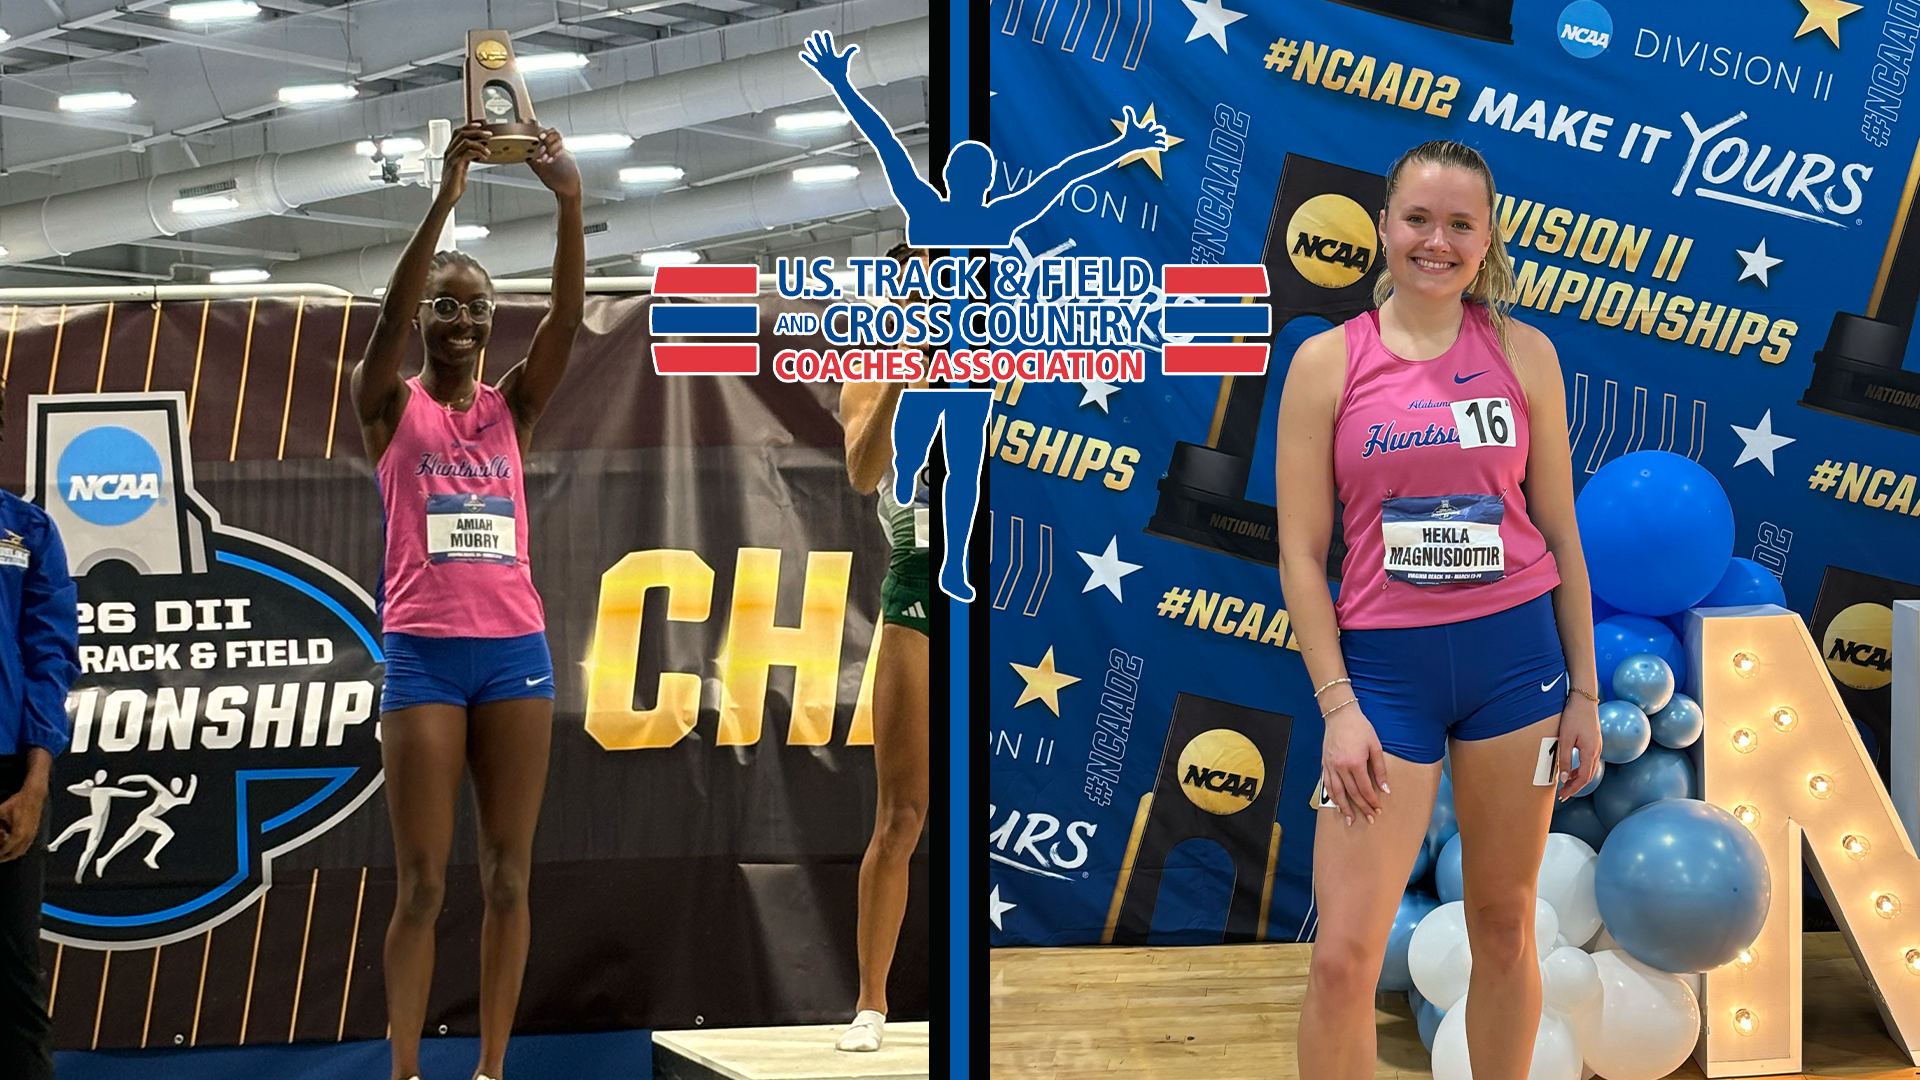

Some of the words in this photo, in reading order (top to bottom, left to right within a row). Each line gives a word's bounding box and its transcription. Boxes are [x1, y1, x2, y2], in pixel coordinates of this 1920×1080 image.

[1561, 24, 1609, 48] NCAA
[1263, 37, 1461, 118] #NCAAD2
[1635, 28, 1801, 93] DIVISION
[1814, 70, 1833, 101] II
[1468, 86, 1614, 152] MAKE
[1618, 122, 1672, 163] IT
[1671, 110, 1873, 215] YOURS
[1141, 202, 1158, 232] II
[1291, 232, 1371, 274] NCAA
[1652, 234, 1694, 282] II
[1865, 383, 1920, 410] NATIONA
[1465, 400, 1508, 445] 16
[415, 452, 512, 479] Huntsville
[68, 473, 159, 501] NCAA
[1808, 459, 1920, 517] #NCA
[450, 533, 499, 549] MURRY
[456, 518, 493, 532] AMIAH
[1209, 513, 1272, 541] NATIONAL
[1422, 528, 1469, 544] HEKLA
[1389, 546, 1499, 567] MAGNUSDOTTIR
[155, 599, 251, 632] DII
[1157, 586, 1301, 652] #NCAA
[190, 642, 217, 669] &
[226, 638, 334, 668] FIELD
[64, 680, 382, 753] IONSHIP
[1084, 648, 1144, 807] #NCAAD2
[1184, 764, 1258, 801] NCAA
